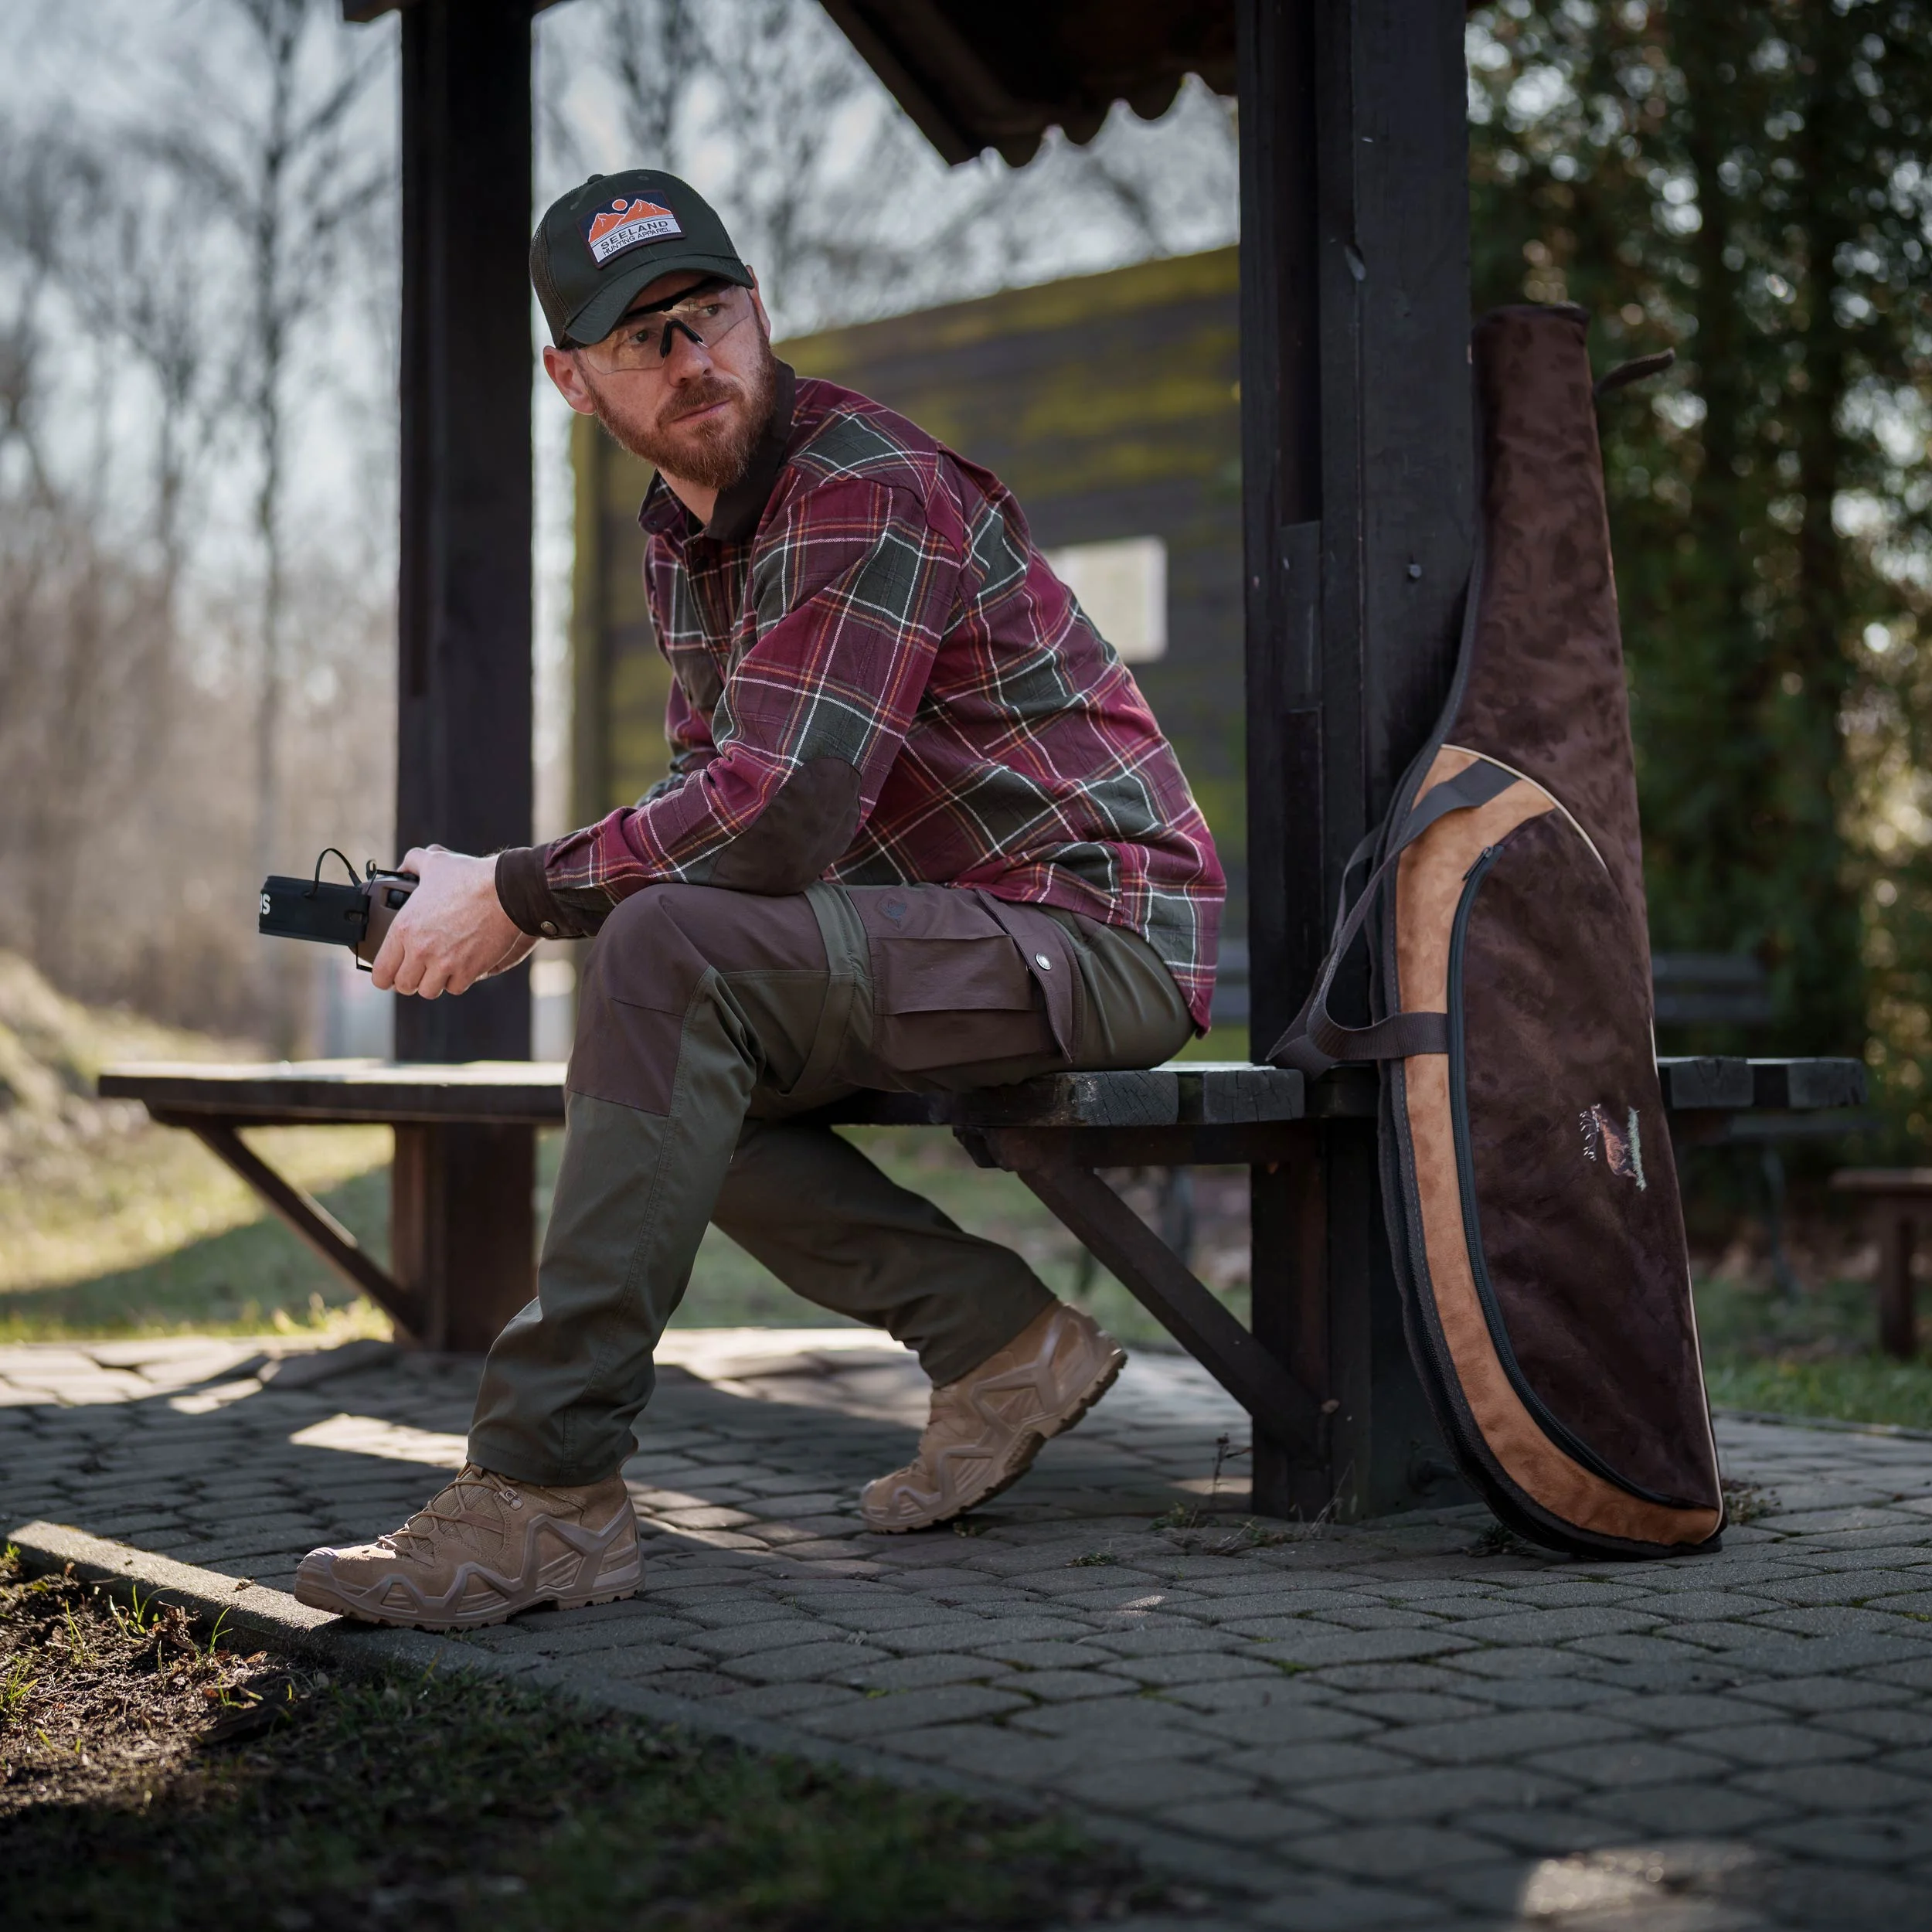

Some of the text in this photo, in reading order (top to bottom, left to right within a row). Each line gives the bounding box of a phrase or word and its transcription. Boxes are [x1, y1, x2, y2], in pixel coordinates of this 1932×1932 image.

[600, 220, 668, 250] SEELAND
[603, 227, 672, 256] HUNTING APPAREL
